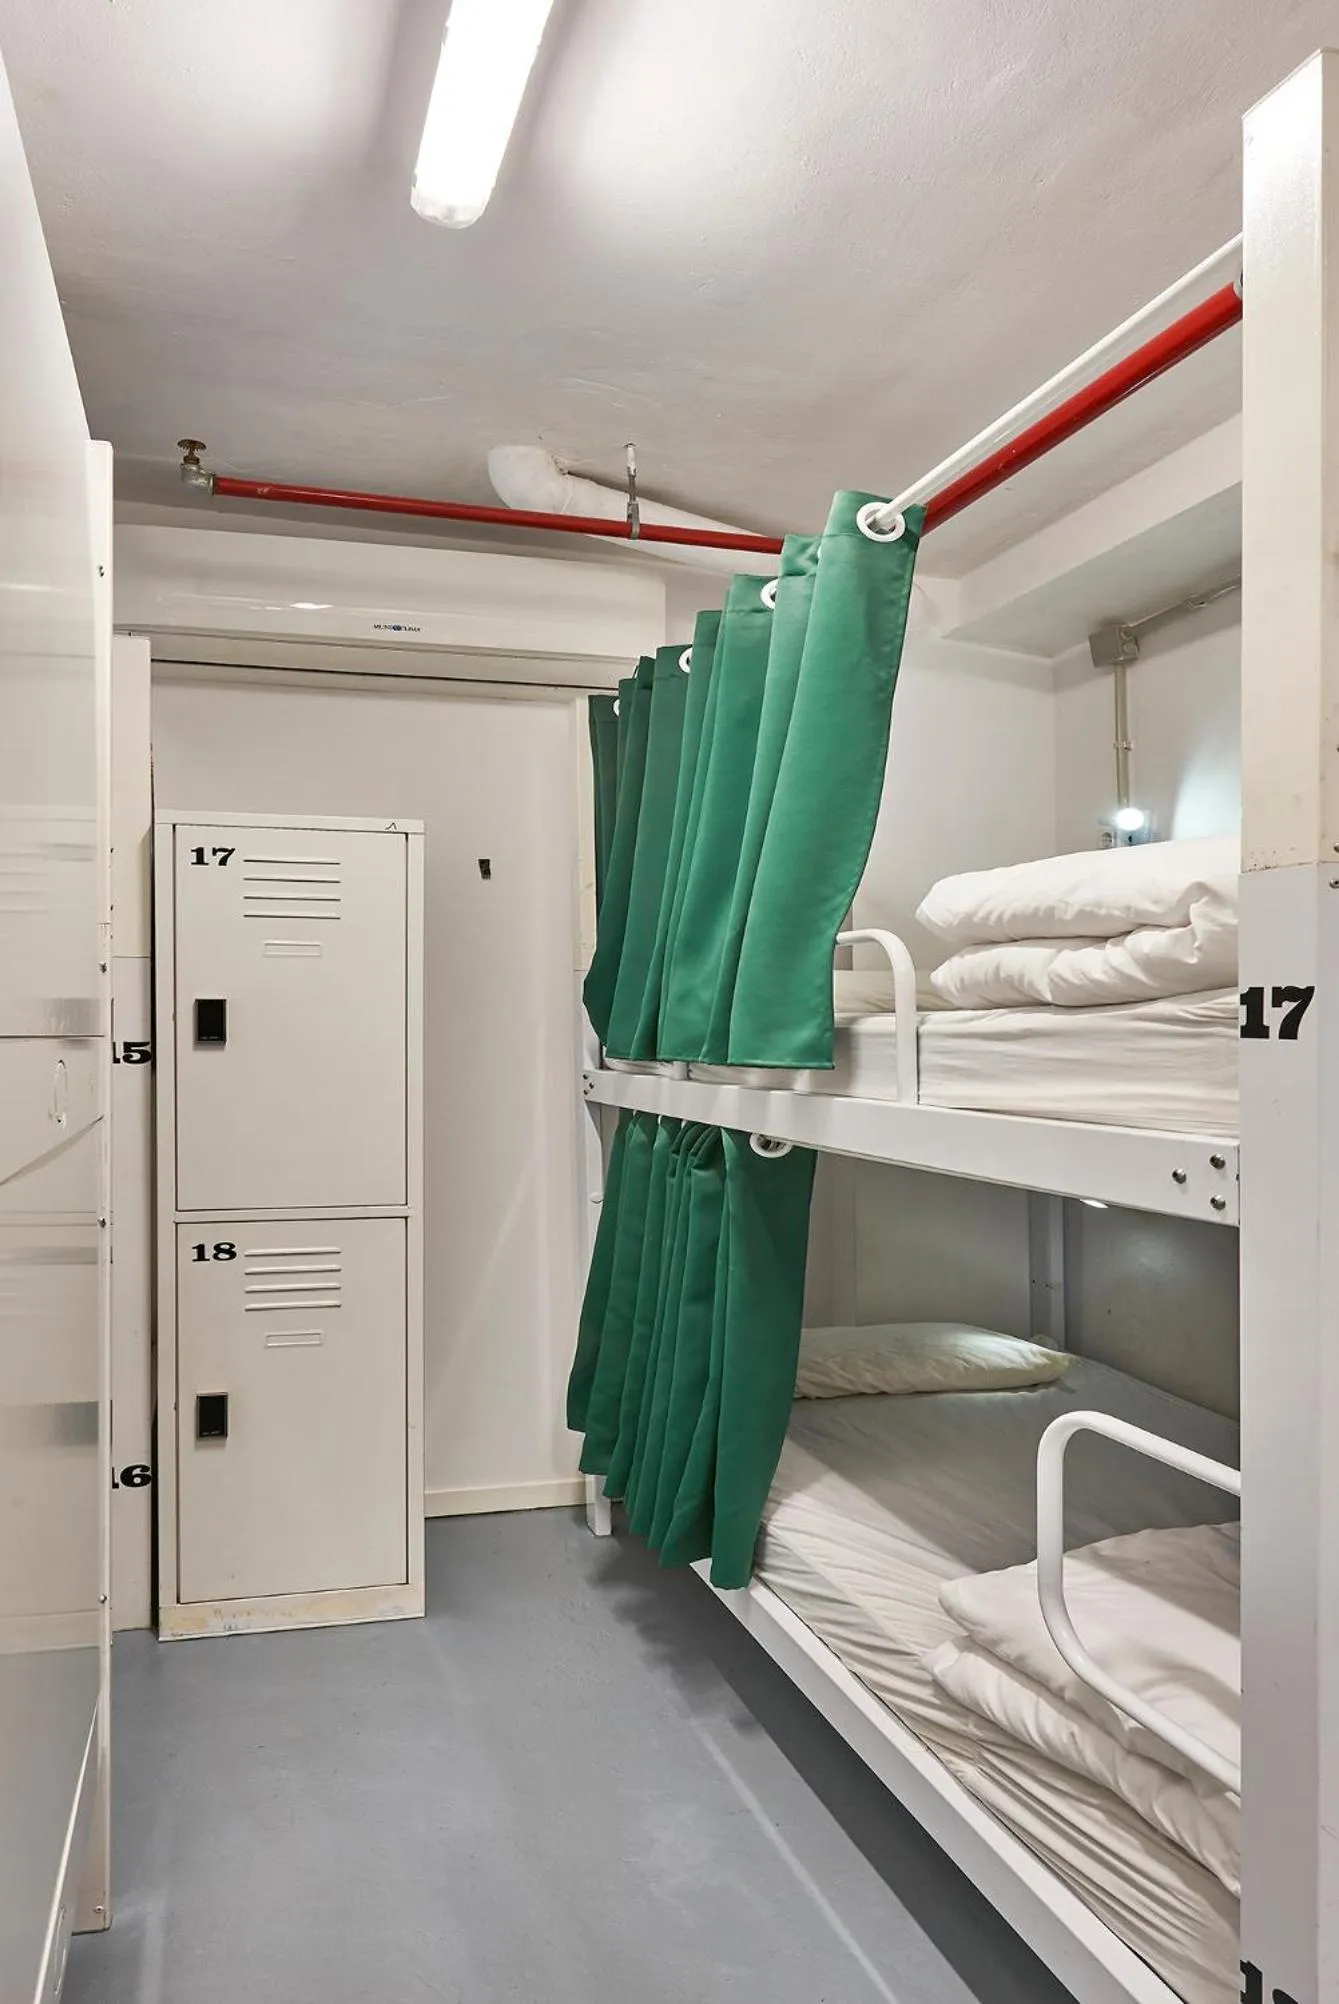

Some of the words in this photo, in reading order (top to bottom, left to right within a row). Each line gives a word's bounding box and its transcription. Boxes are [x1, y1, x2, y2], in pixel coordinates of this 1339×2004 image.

[190, 846, 236, 867] 17
[1239, 985, 1315, 1040] 17
[191, 1241, 237, 1262] 18
[111, 1464, 152, 1489] 6
